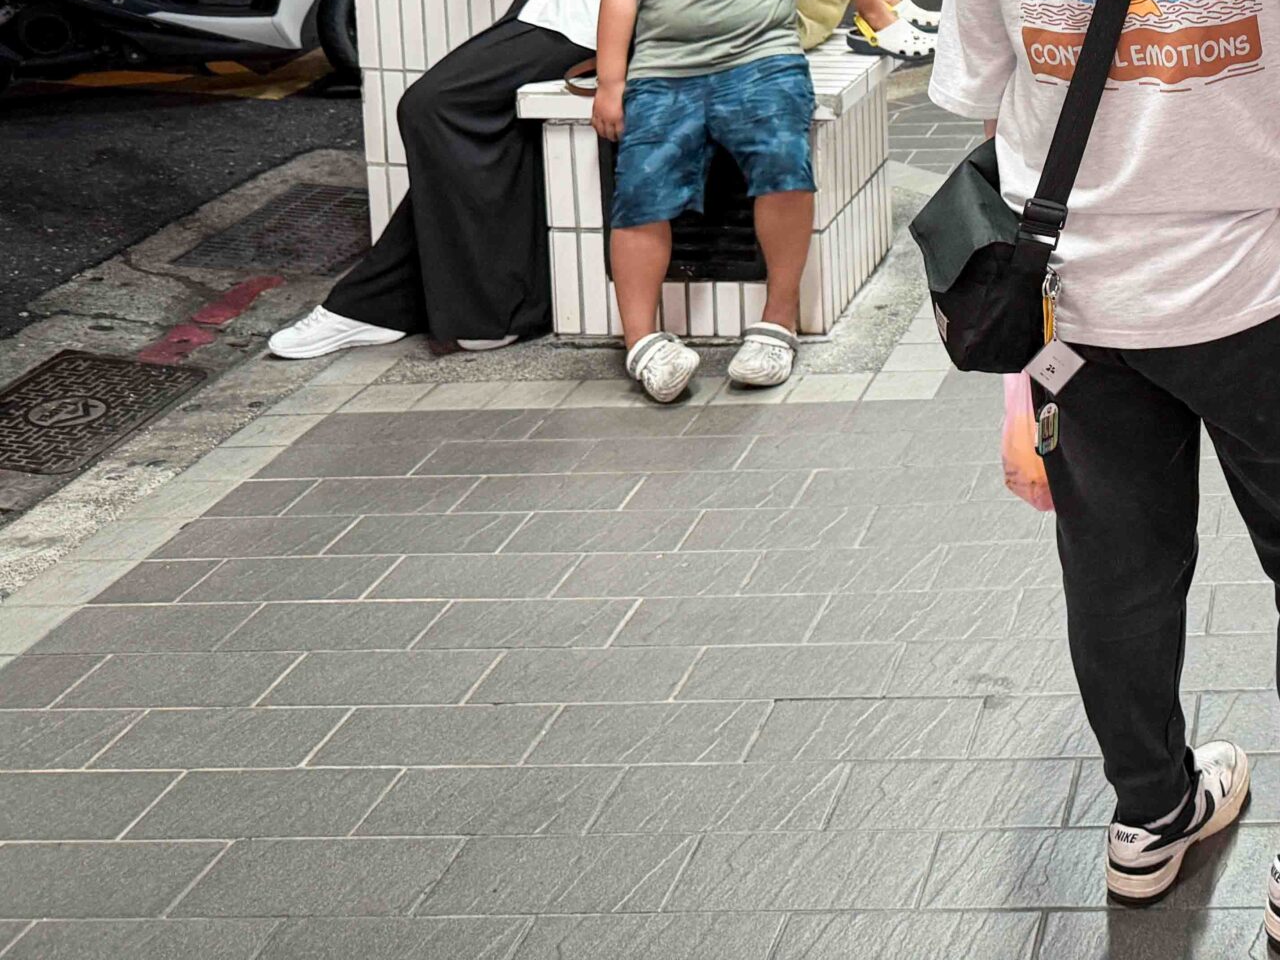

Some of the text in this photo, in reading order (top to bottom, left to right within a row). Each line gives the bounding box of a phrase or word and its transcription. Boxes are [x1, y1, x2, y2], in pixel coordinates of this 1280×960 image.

[1030, 34, 1250, 69] CONTL EMOTIONS
[1114, 829, 1139, 844] NIKE
